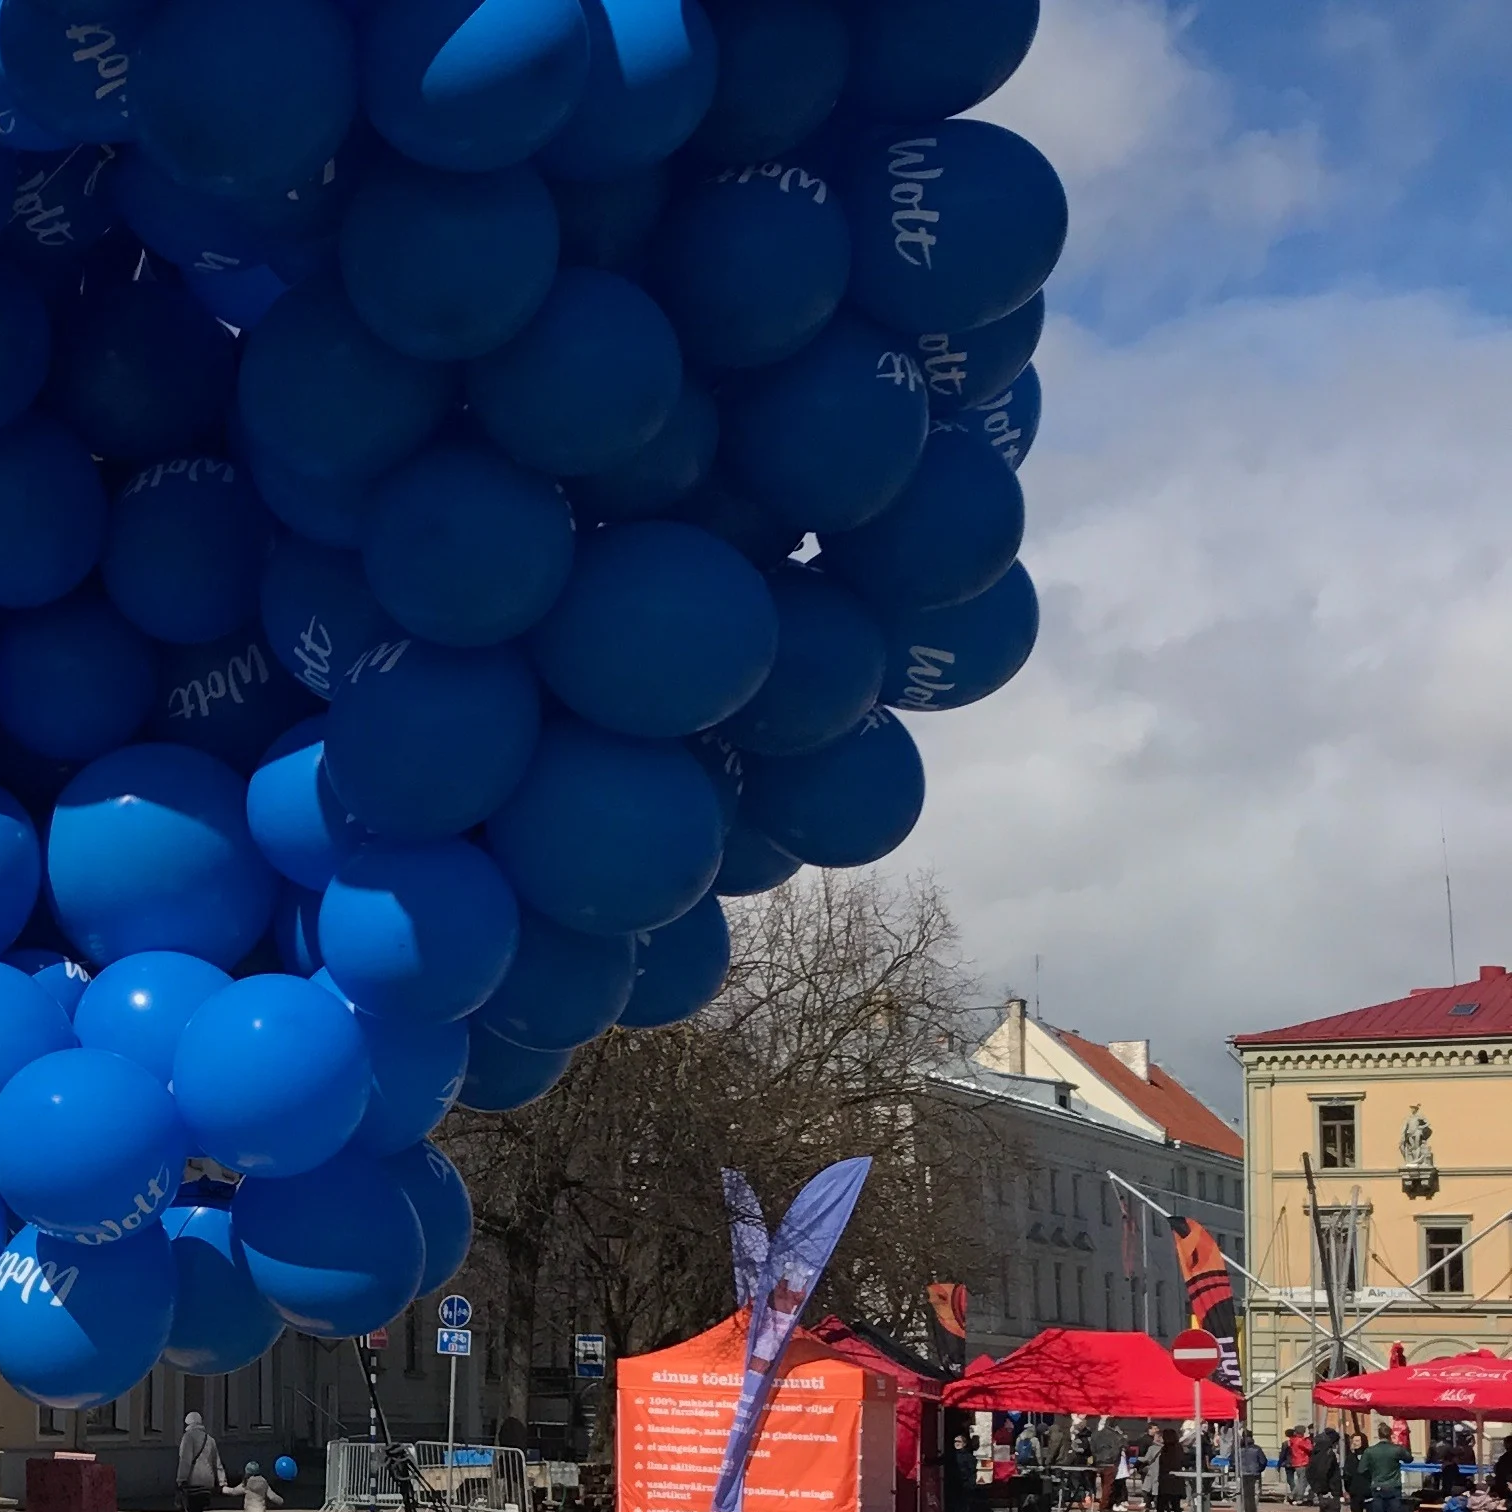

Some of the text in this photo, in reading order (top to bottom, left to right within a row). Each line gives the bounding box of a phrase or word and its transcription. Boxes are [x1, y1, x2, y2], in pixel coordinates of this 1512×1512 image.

[704, 160, 827, 205] Wolt
[888, 138, 945, 271] Wolt
[918, 333, 969, 396] olt
[123, 457, 235, 499] Wolt
[168, 643, 270, 720] Wolt
[292, 614, 334, 701] olt
[74, 1165, 171, 1246] Wolt
[651, 1370, 699, 1385] ainus
[702, 1372, 744, 1387] tõeli
